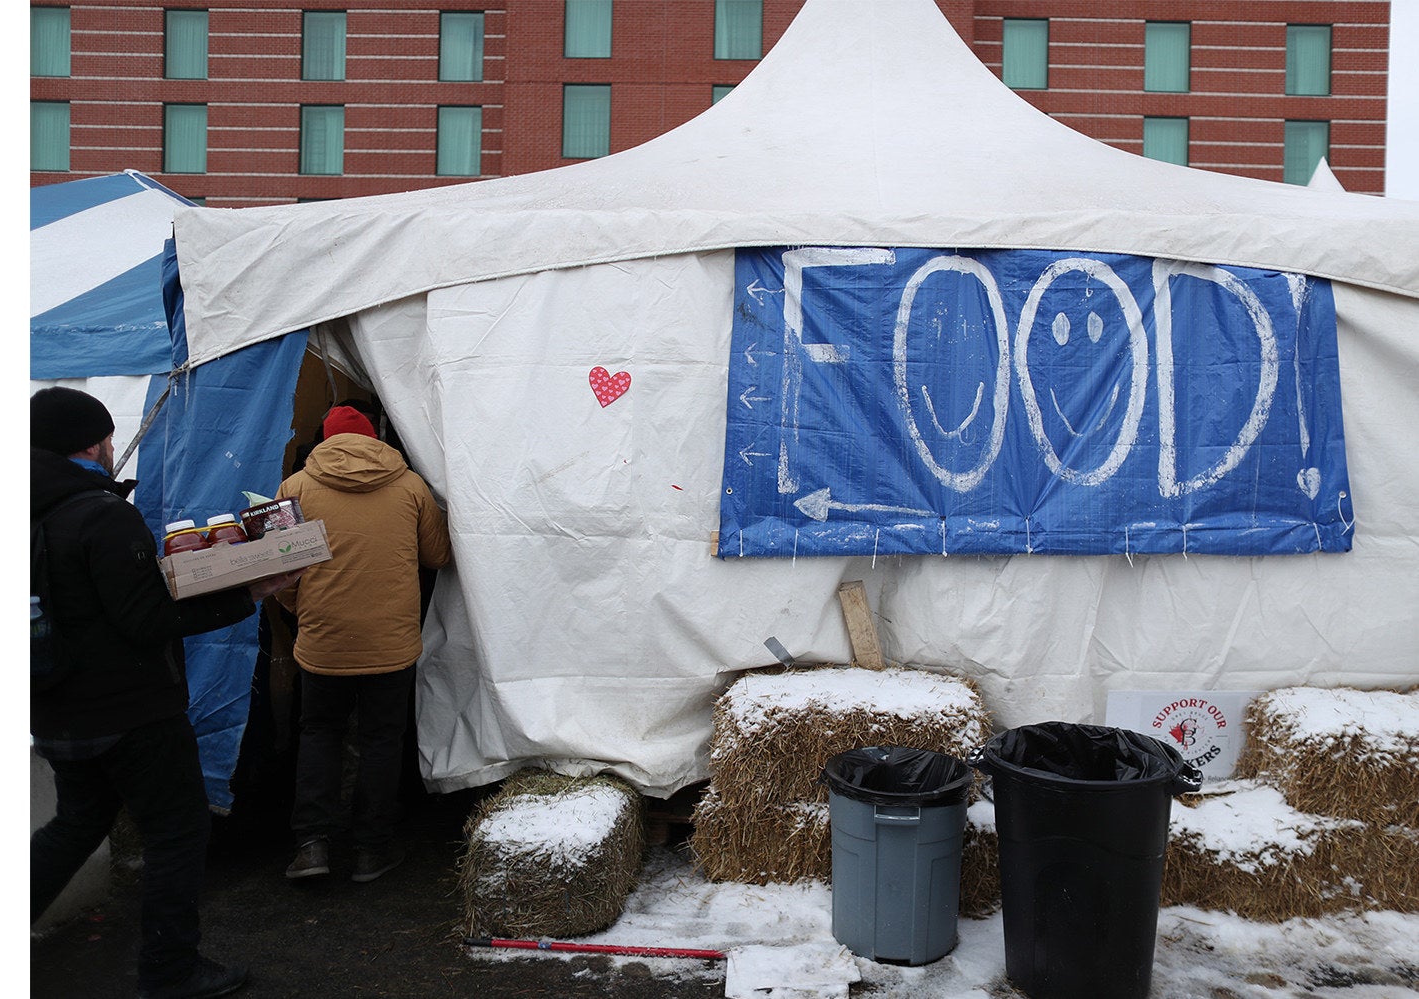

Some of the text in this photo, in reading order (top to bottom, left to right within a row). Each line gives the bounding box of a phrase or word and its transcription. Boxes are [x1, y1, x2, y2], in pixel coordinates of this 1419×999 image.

[777, 246, 1321, 500] FOOD!
[249, 504, 280, 518] KIRKLAND
[291, 536, 318, 548] Mucci
[1152, 698, 1227, 729] SUPPORT OUR
[1183, 744, 1221, 769] KERS
